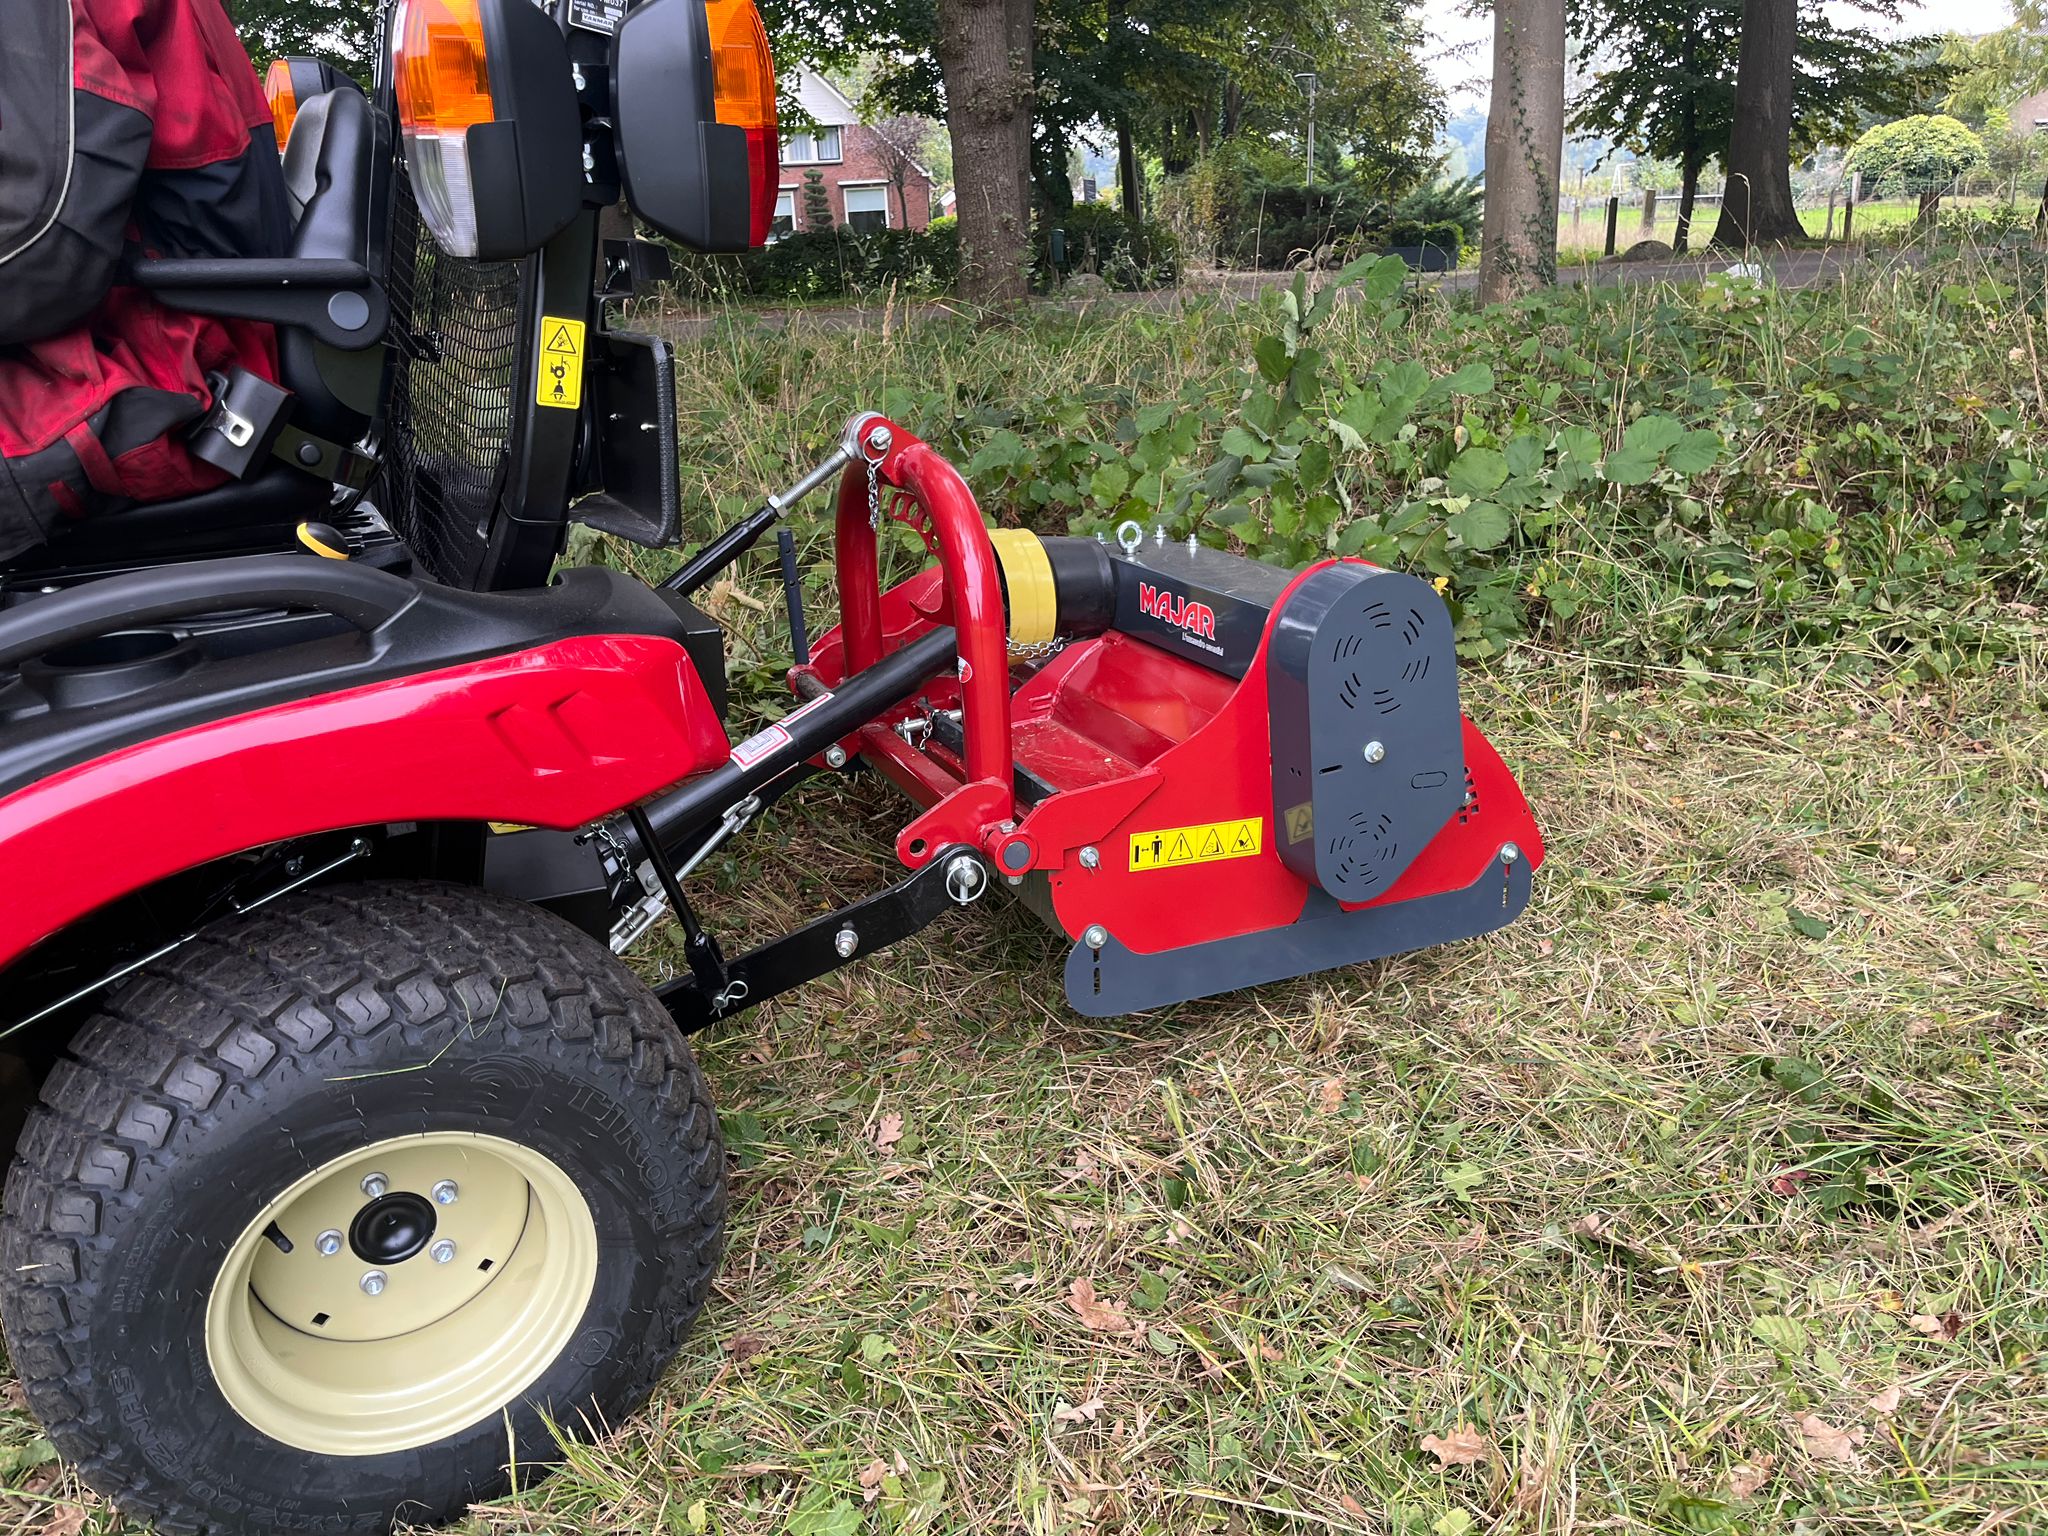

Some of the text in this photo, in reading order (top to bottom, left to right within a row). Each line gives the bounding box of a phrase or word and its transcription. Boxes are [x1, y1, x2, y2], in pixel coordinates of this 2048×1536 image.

[583, 14, 613, 27] YANMAR
[1139, 581, 1216, 642] MAJAR
[567, 1073, 680, 1234] TIRON
